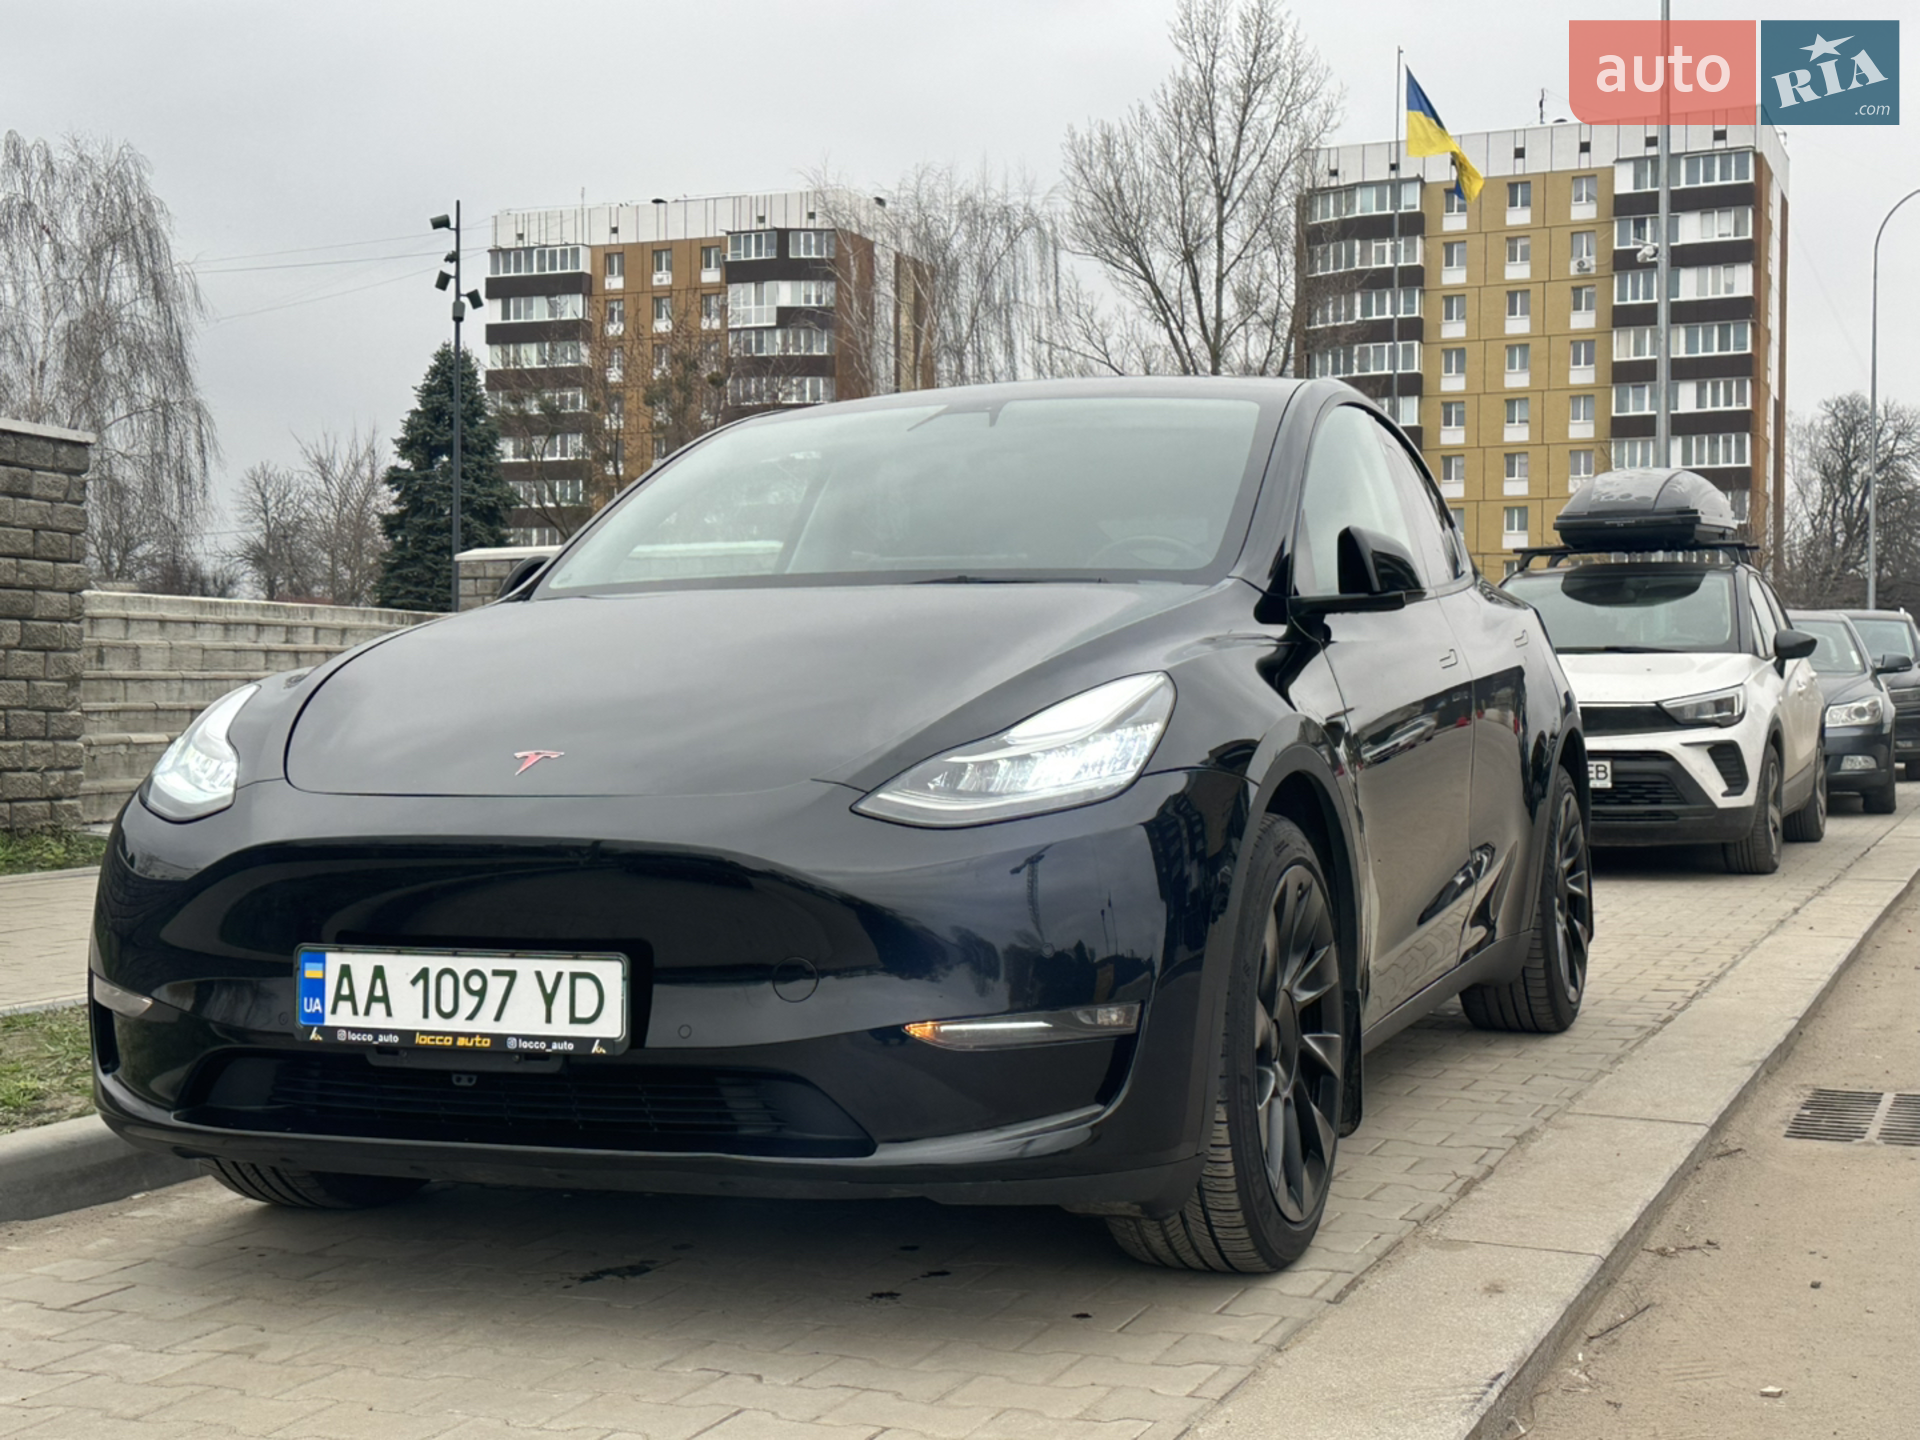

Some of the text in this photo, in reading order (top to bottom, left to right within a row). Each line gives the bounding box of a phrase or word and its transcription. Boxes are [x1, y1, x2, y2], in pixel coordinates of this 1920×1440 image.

[330, 963, 605, 1025] AA 1097 YD
[303, 997, 323, 1014] UA
[415, 1032, 492, 1048] locco auto
